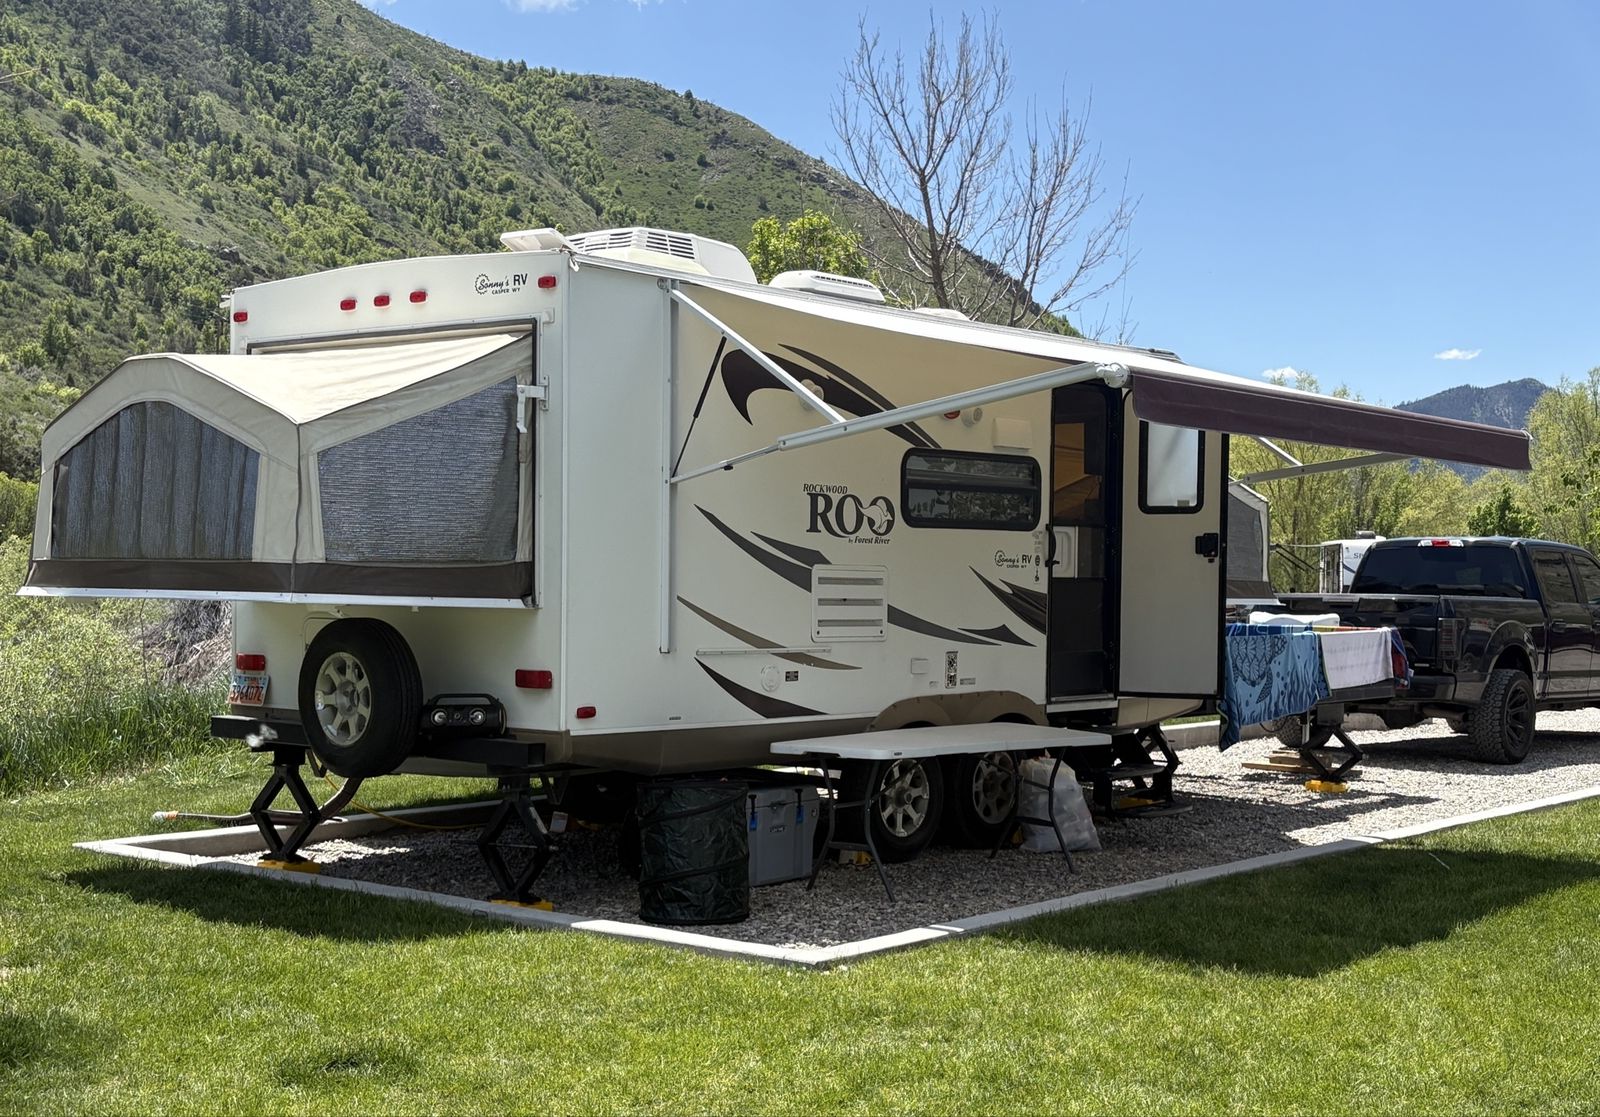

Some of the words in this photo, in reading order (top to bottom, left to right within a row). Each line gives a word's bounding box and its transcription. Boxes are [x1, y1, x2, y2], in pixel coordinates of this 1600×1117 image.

[513, 273, 528, 286] RV
[803, 483, 848, 494] ROCKWOOD
[806, 492, 895, 538] ROO
[854, 535, 873, 544] Forest
[874, 536, 890, 545] River
[1021, 554, 1032, 564] RV
